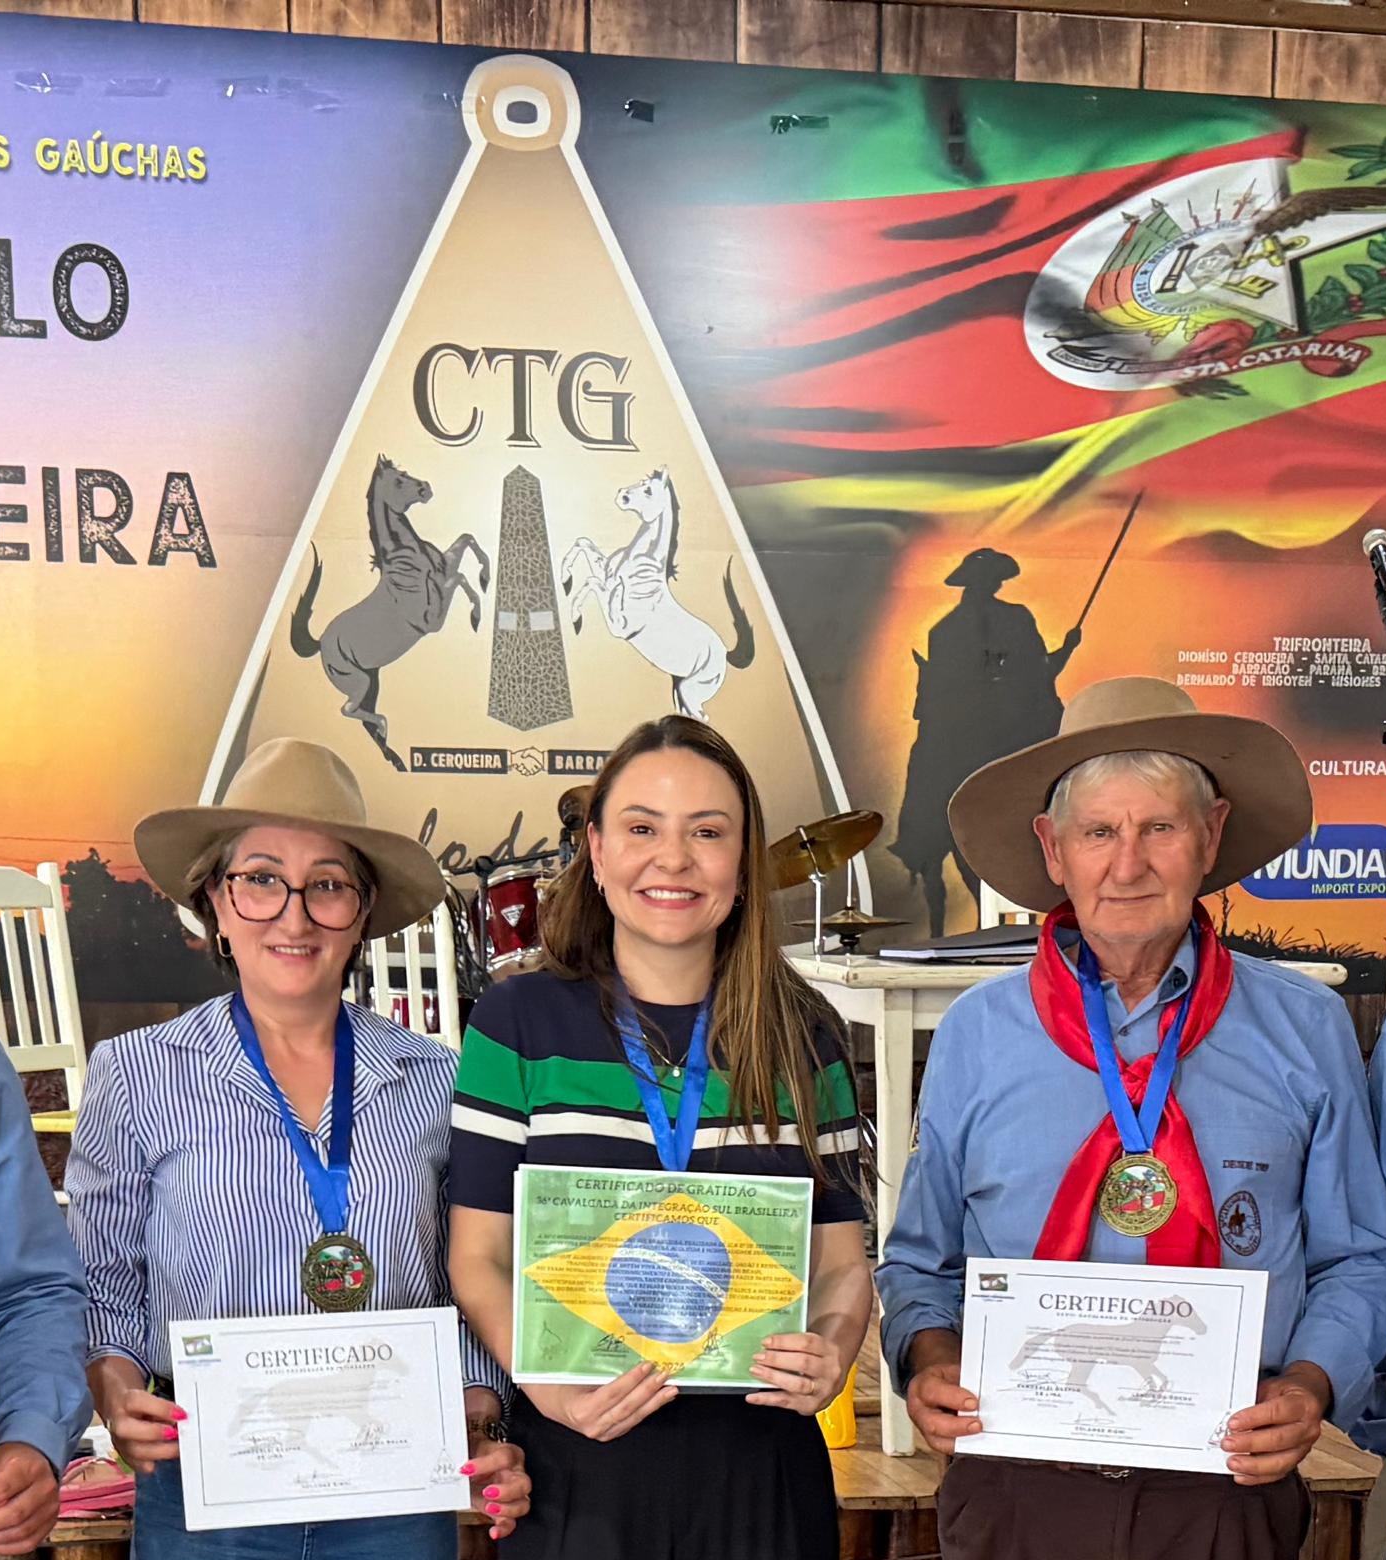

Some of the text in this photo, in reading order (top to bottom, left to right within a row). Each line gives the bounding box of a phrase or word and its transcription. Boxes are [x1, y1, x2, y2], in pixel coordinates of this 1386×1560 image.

[35, 131, 208, 181] GAÚCHAS
[413, 342, 640, 452] CTG
[1273, 637, 1372, 653] TRIFRONTEIRA
[1234, 652, 1295, 664] CERQUEIRA
[1314, 653, 1351, 665] SANTA
[1176, 673, 1236, 687] BERNARDO
[1241, 674, 1256, 686] DE
[413, 752, 427, 768] D.
[430, 752, 502, 769] CERQUEIRA
[1311, 883, 1354, 894] IMPORT
[575, 1178, 664, 1193] CERTIFICADO
[667, 1182, 685, 1193] DE
[620, 1200, 638, 1210] DA
[712, 1205, 732, 1215] SUL
[734, 1206, 800, 1218] BRASILEIRA
[1038, 1292, 1194, 1319] CERTIFICADO
[245, 1343, 394, 1370] CERTIFICADO
